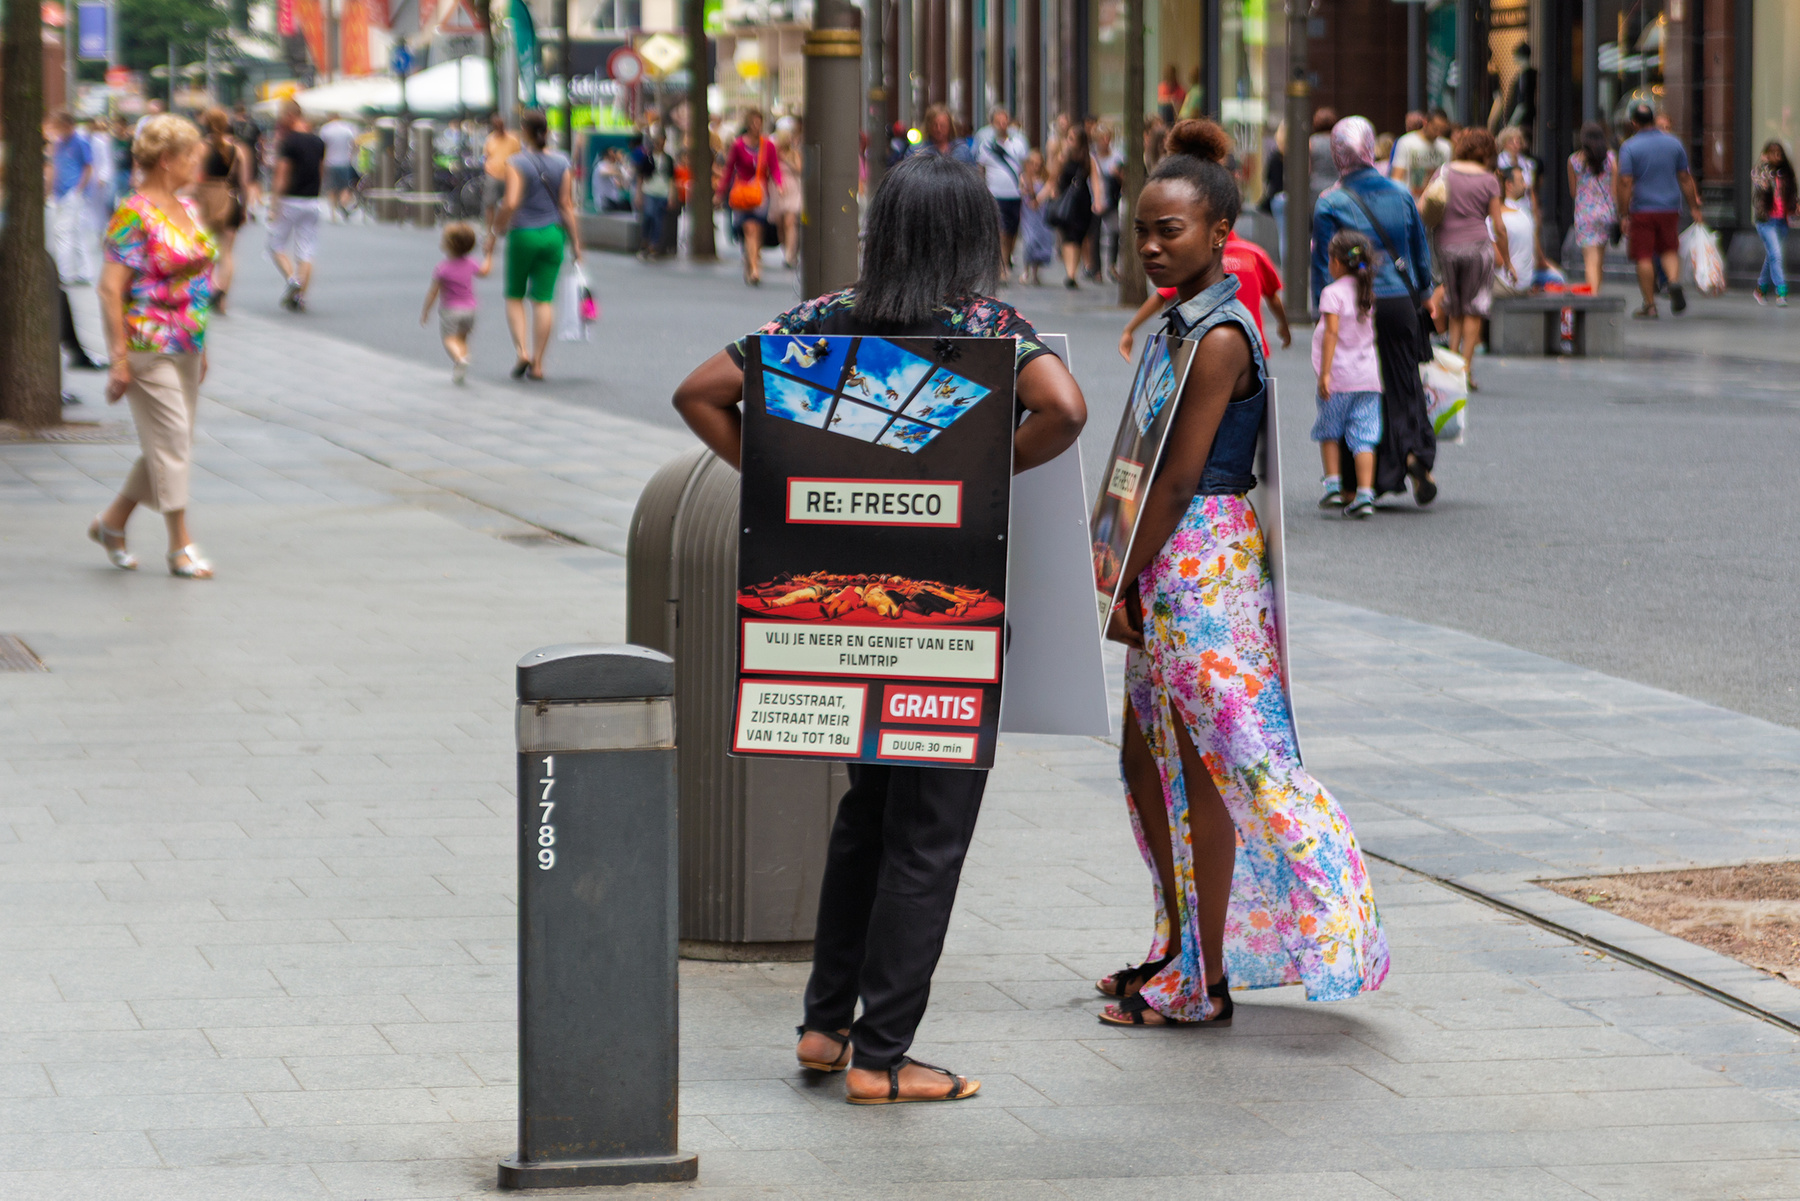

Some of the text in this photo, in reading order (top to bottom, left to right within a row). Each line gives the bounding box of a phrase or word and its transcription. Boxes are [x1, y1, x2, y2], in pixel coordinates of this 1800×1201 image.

[806, 491, 941, 515] RE: FRESCO
[765, 632, 974, 651] VLIJ JE NEER EN GENIET VAN EEN
[839, 653, 898, 667] FILMTRIP
[758, 692, 846, 709] JEZUSSTRAAT,
[889, 693, 976, 720] GRATIS
[751, 711, 850, 727] ZIJSTRAAT MEIR
[746, 730, 850, 745] VAN 12u TOT 18u
[892, 741, 961, 753] DUUR: 30 min
[537, 755, 556, 870] 17789
